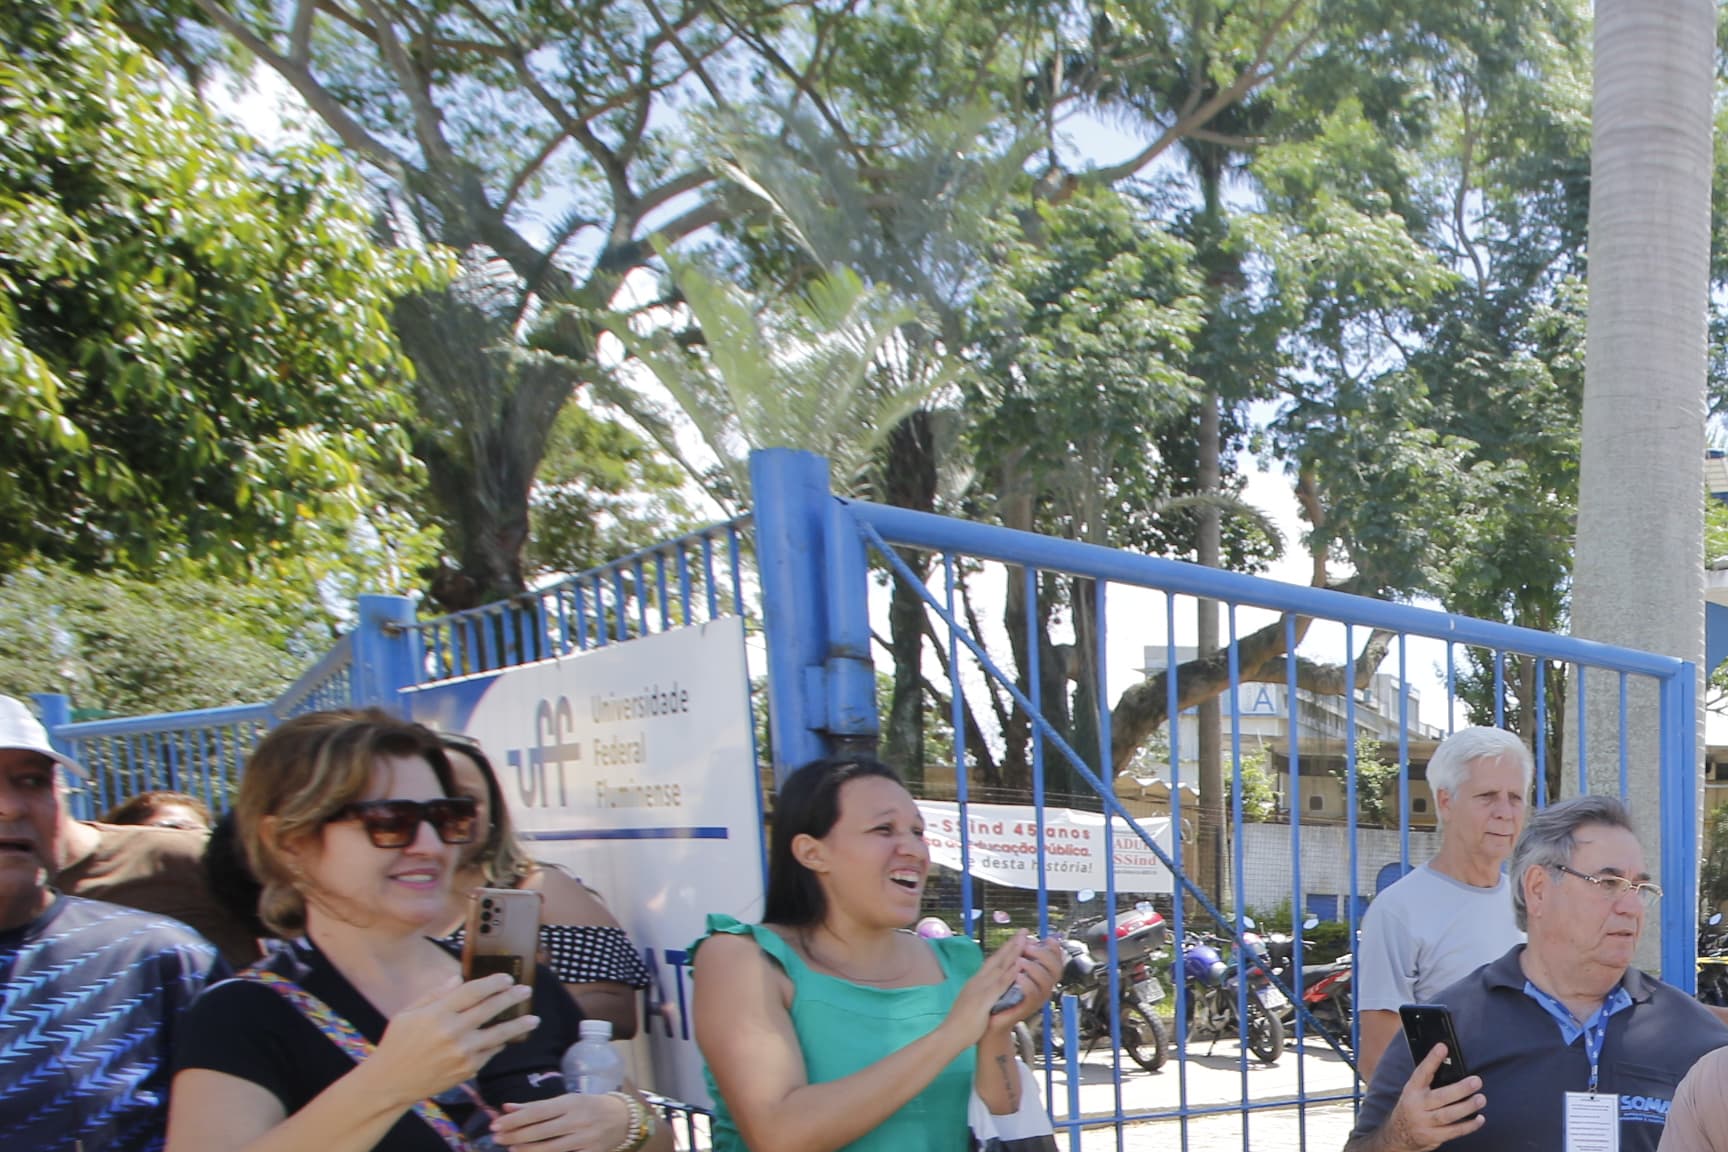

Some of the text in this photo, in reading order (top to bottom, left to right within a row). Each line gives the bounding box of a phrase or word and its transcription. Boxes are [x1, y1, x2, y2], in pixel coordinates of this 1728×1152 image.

[591, 681, 690, 724] Universidade
[593, 731, 646, 765] Federal
[1014, 823, 1037, 837] 45
[1046, 827, 1090, 840] anos
[983, 855, 1025, 870] desta
[1032, 859, 1093, 874] hstória!
